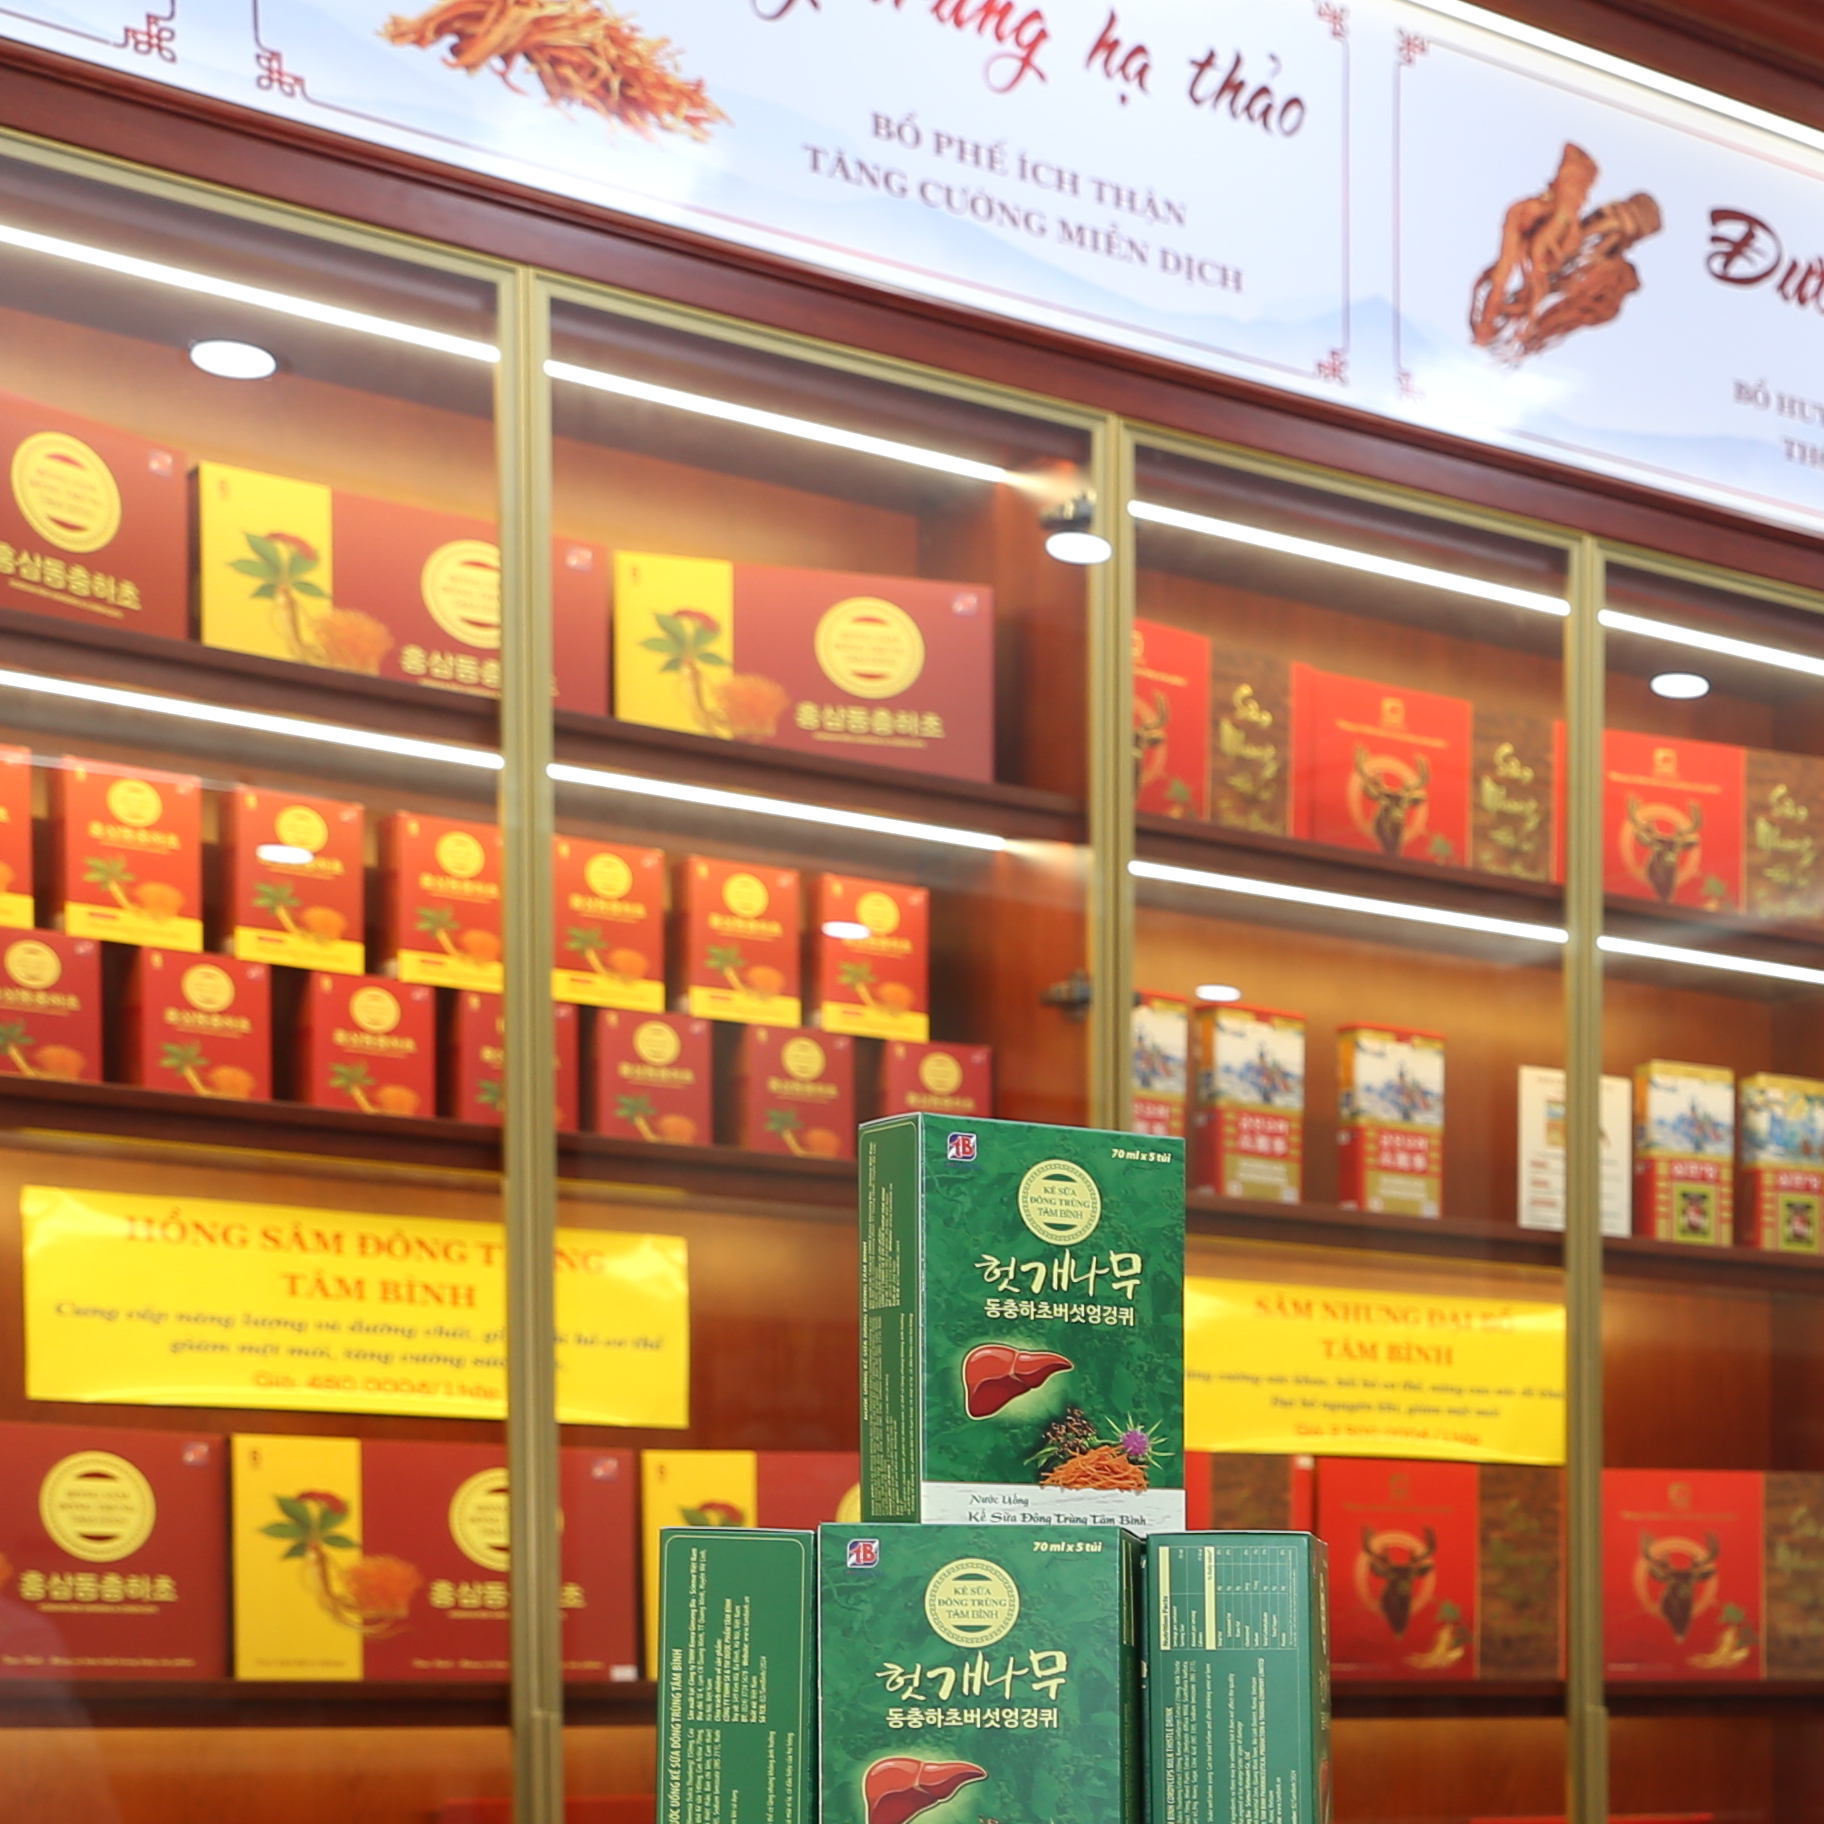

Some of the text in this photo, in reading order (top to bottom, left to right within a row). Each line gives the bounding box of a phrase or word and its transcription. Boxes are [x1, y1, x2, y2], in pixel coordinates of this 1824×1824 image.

[1083, 8, 1152, 107] hạ
[1187, 48, 1307, 137] thảo
[870, 109, 1188, 228] BỔ PHẾ ÍCH THẬN
[804, 145, 1245, 294] TĂNG CƯỜNG MIỄN DỊCH
[281, 1271, 477, 1309] TÂM BÌNH
[974, 1248, 1144, 1301] 헛개나무
[984, 1298, 1136, 1327] 동충하초버섯엉겅퀴
[875, 1648, 1069, 1702] 헛개나무
[886, 1707, 1058, 1730] 동충하초버섯엉겅퀴
